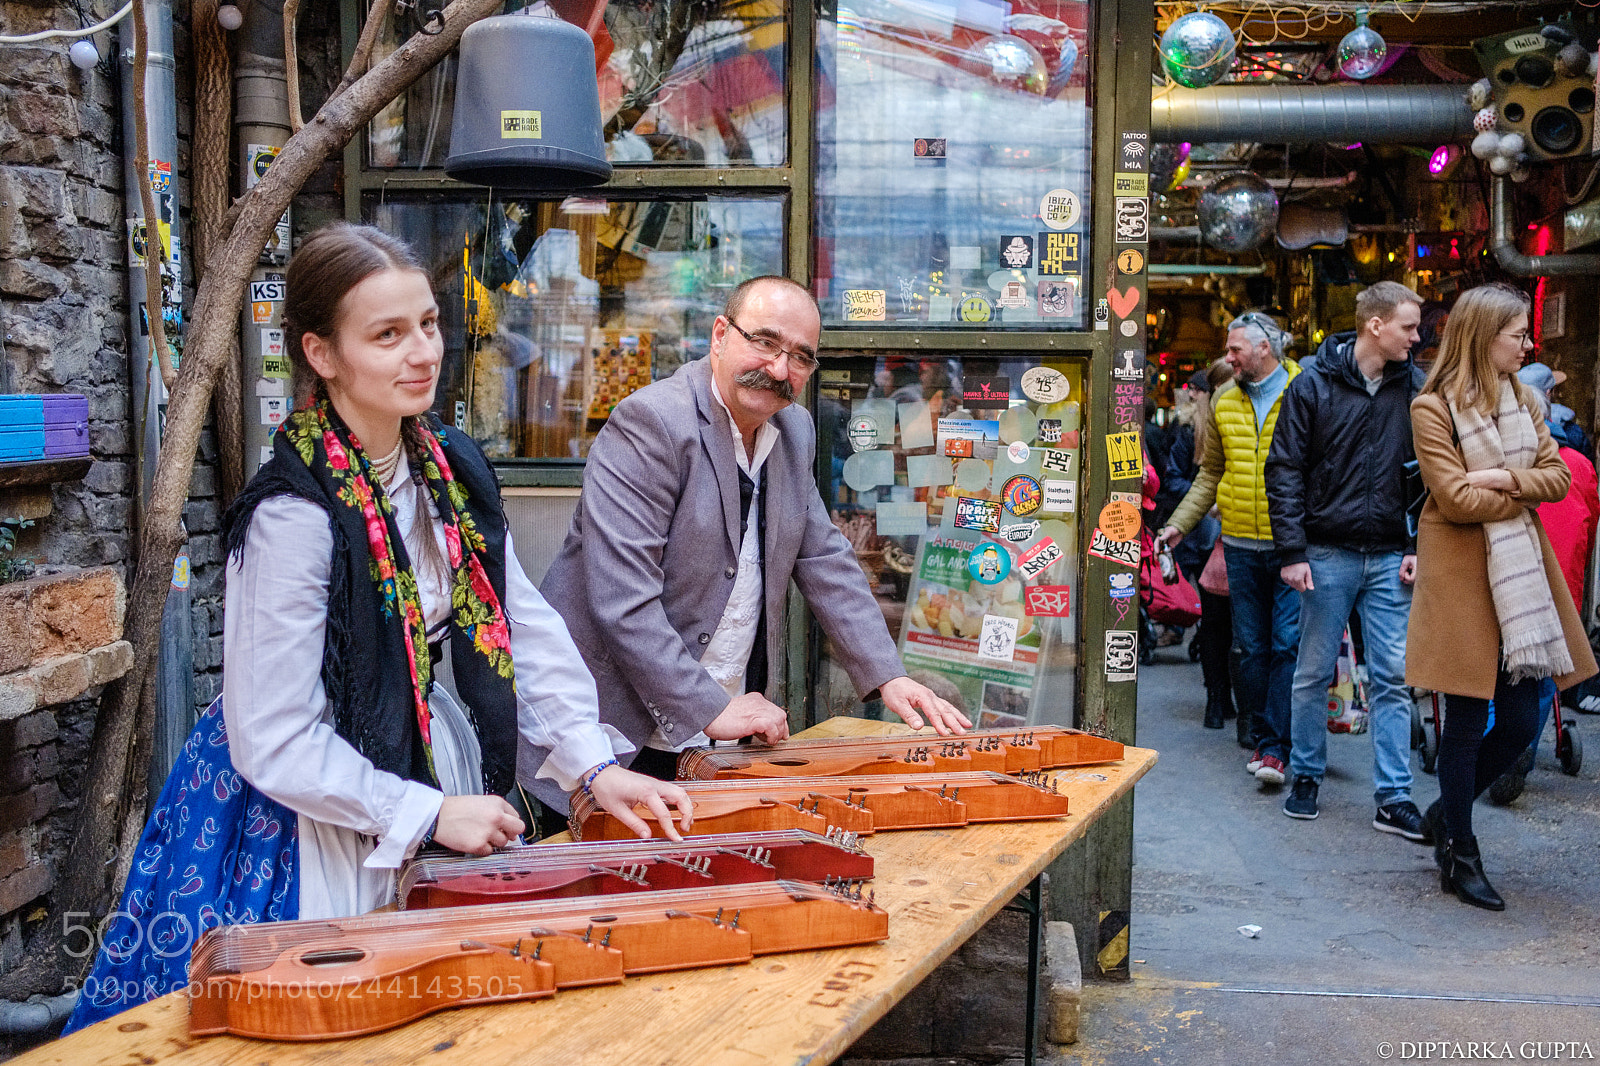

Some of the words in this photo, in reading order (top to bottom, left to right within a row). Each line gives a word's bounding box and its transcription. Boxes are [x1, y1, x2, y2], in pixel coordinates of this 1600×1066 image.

[1513, 37, 1541, 50] Hello!
[1122, 132, 1147, 140] TATTOO
[1124, 161, 1142, 169] MIA
[1048, 196, 1073, 206] IBIZA
[1047, 204, 1072, 214] CHILI
[1047, 233, 1079, 248] AUD
[1046, 247, 1078, 261] IOLI
[1009, 530, 1032, 541] EUROPE
